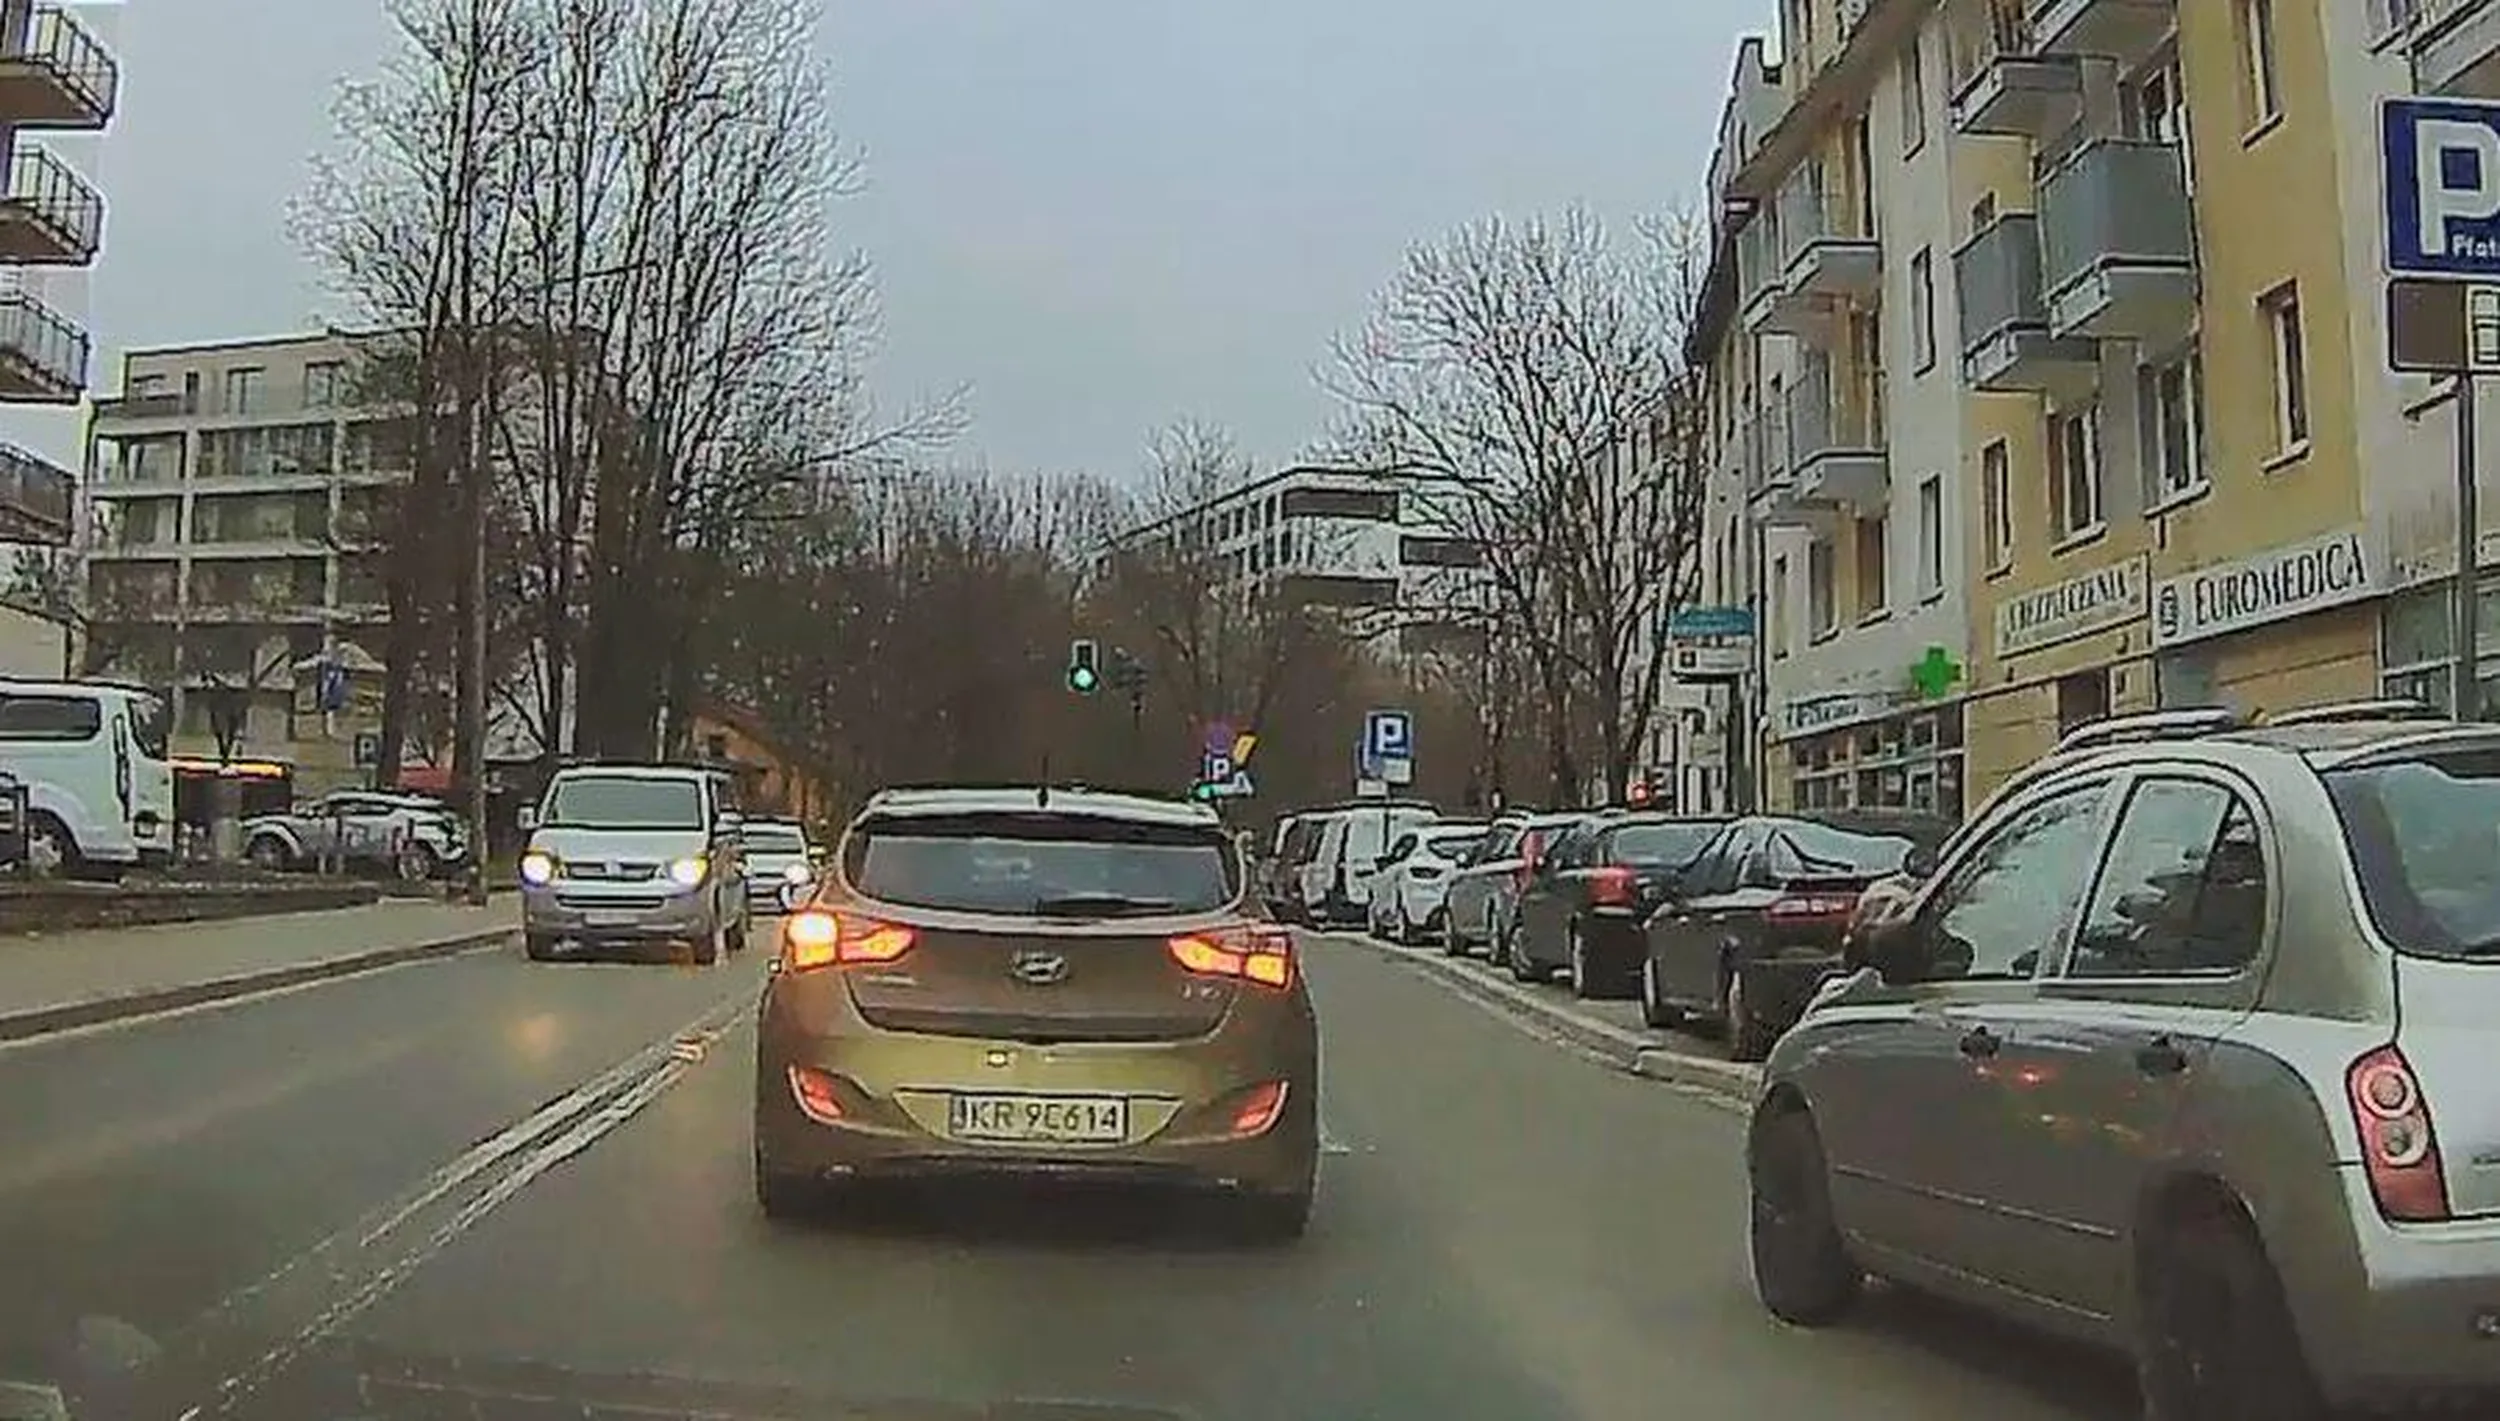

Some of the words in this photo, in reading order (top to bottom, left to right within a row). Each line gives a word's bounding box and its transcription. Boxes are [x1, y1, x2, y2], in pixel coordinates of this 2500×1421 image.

[2416, 118, 2500, 254] P
[2195, 534, 2366, 625] EUROMEDICA
[1377, 717, 1403, 752] P
[1213, 758, 1229, 781] P
[971, 1101, 1014, 1128] KR
